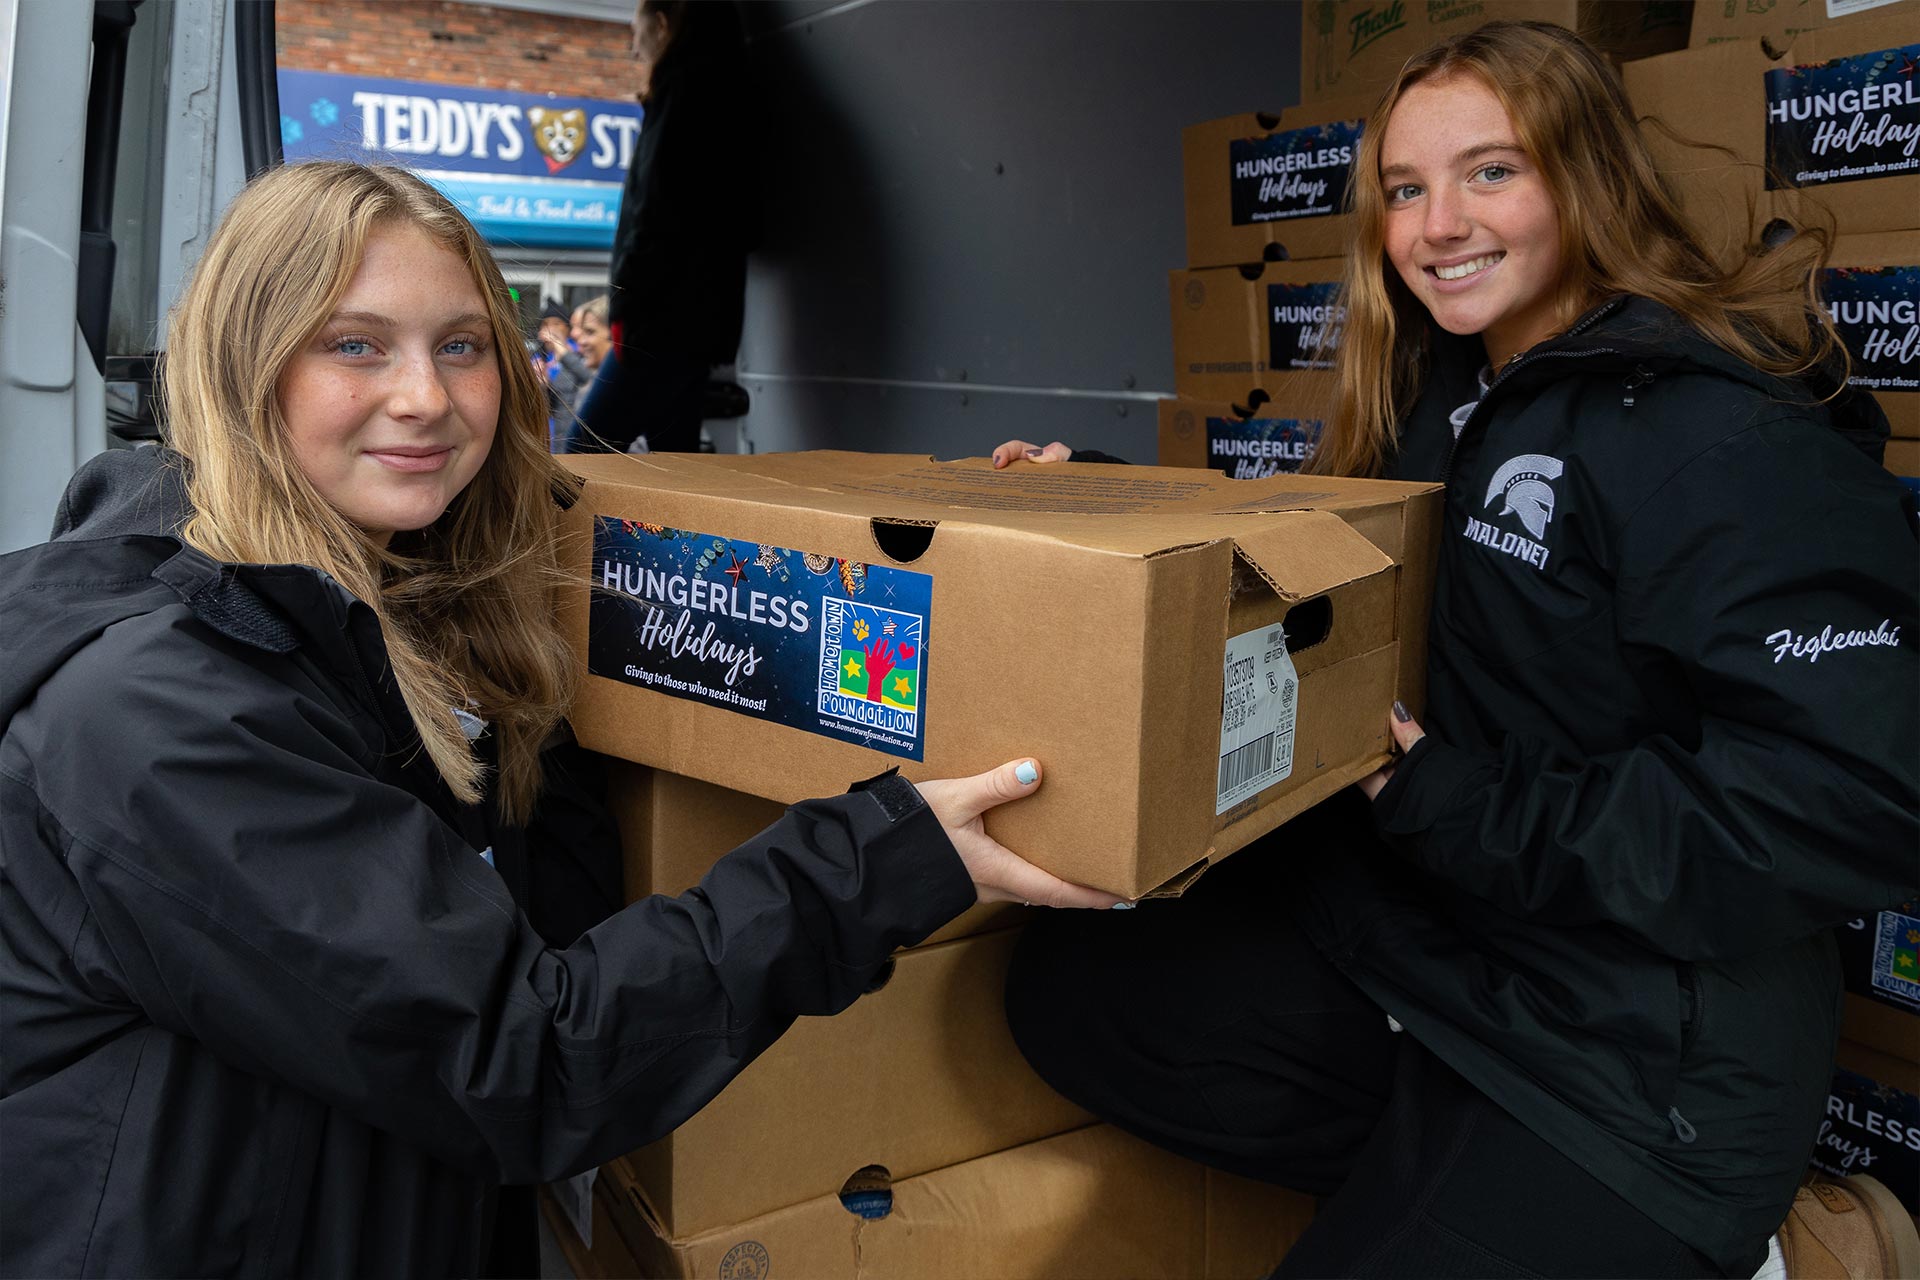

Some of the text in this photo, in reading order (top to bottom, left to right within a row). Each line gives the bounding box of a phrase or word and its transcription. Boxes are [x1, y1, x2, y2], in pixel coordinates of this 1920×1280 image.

[1769, 80, 1920, 124] HUNGERL
[353, 91, 524, 161] TEDDY'S
[1236, 146, 1351, 178] HUNGERLESS
[1796, 170, 1828, 181] Giving
[1829, 169, 1839, 178] to
[1840, 166, 1864, 177] those
[1866, 162, 1886, 173] who
[1887, 158, 1909, 171] need
[1259, 172, 1328, 205] Holidays
[1818, 301, 1920, 324] HUNG
[1848, 376, 1919, 388] Giving to those
[603, 560, 810, 633] HUNGERLESS
[640, 606, 763, 687] Holidays
[1765, 619, 1901, 663] Figlewski
[625, 664, 767, 711] Giving to those who need it most!
[819, 718, 914, 751] www.hometownfoundation.org
